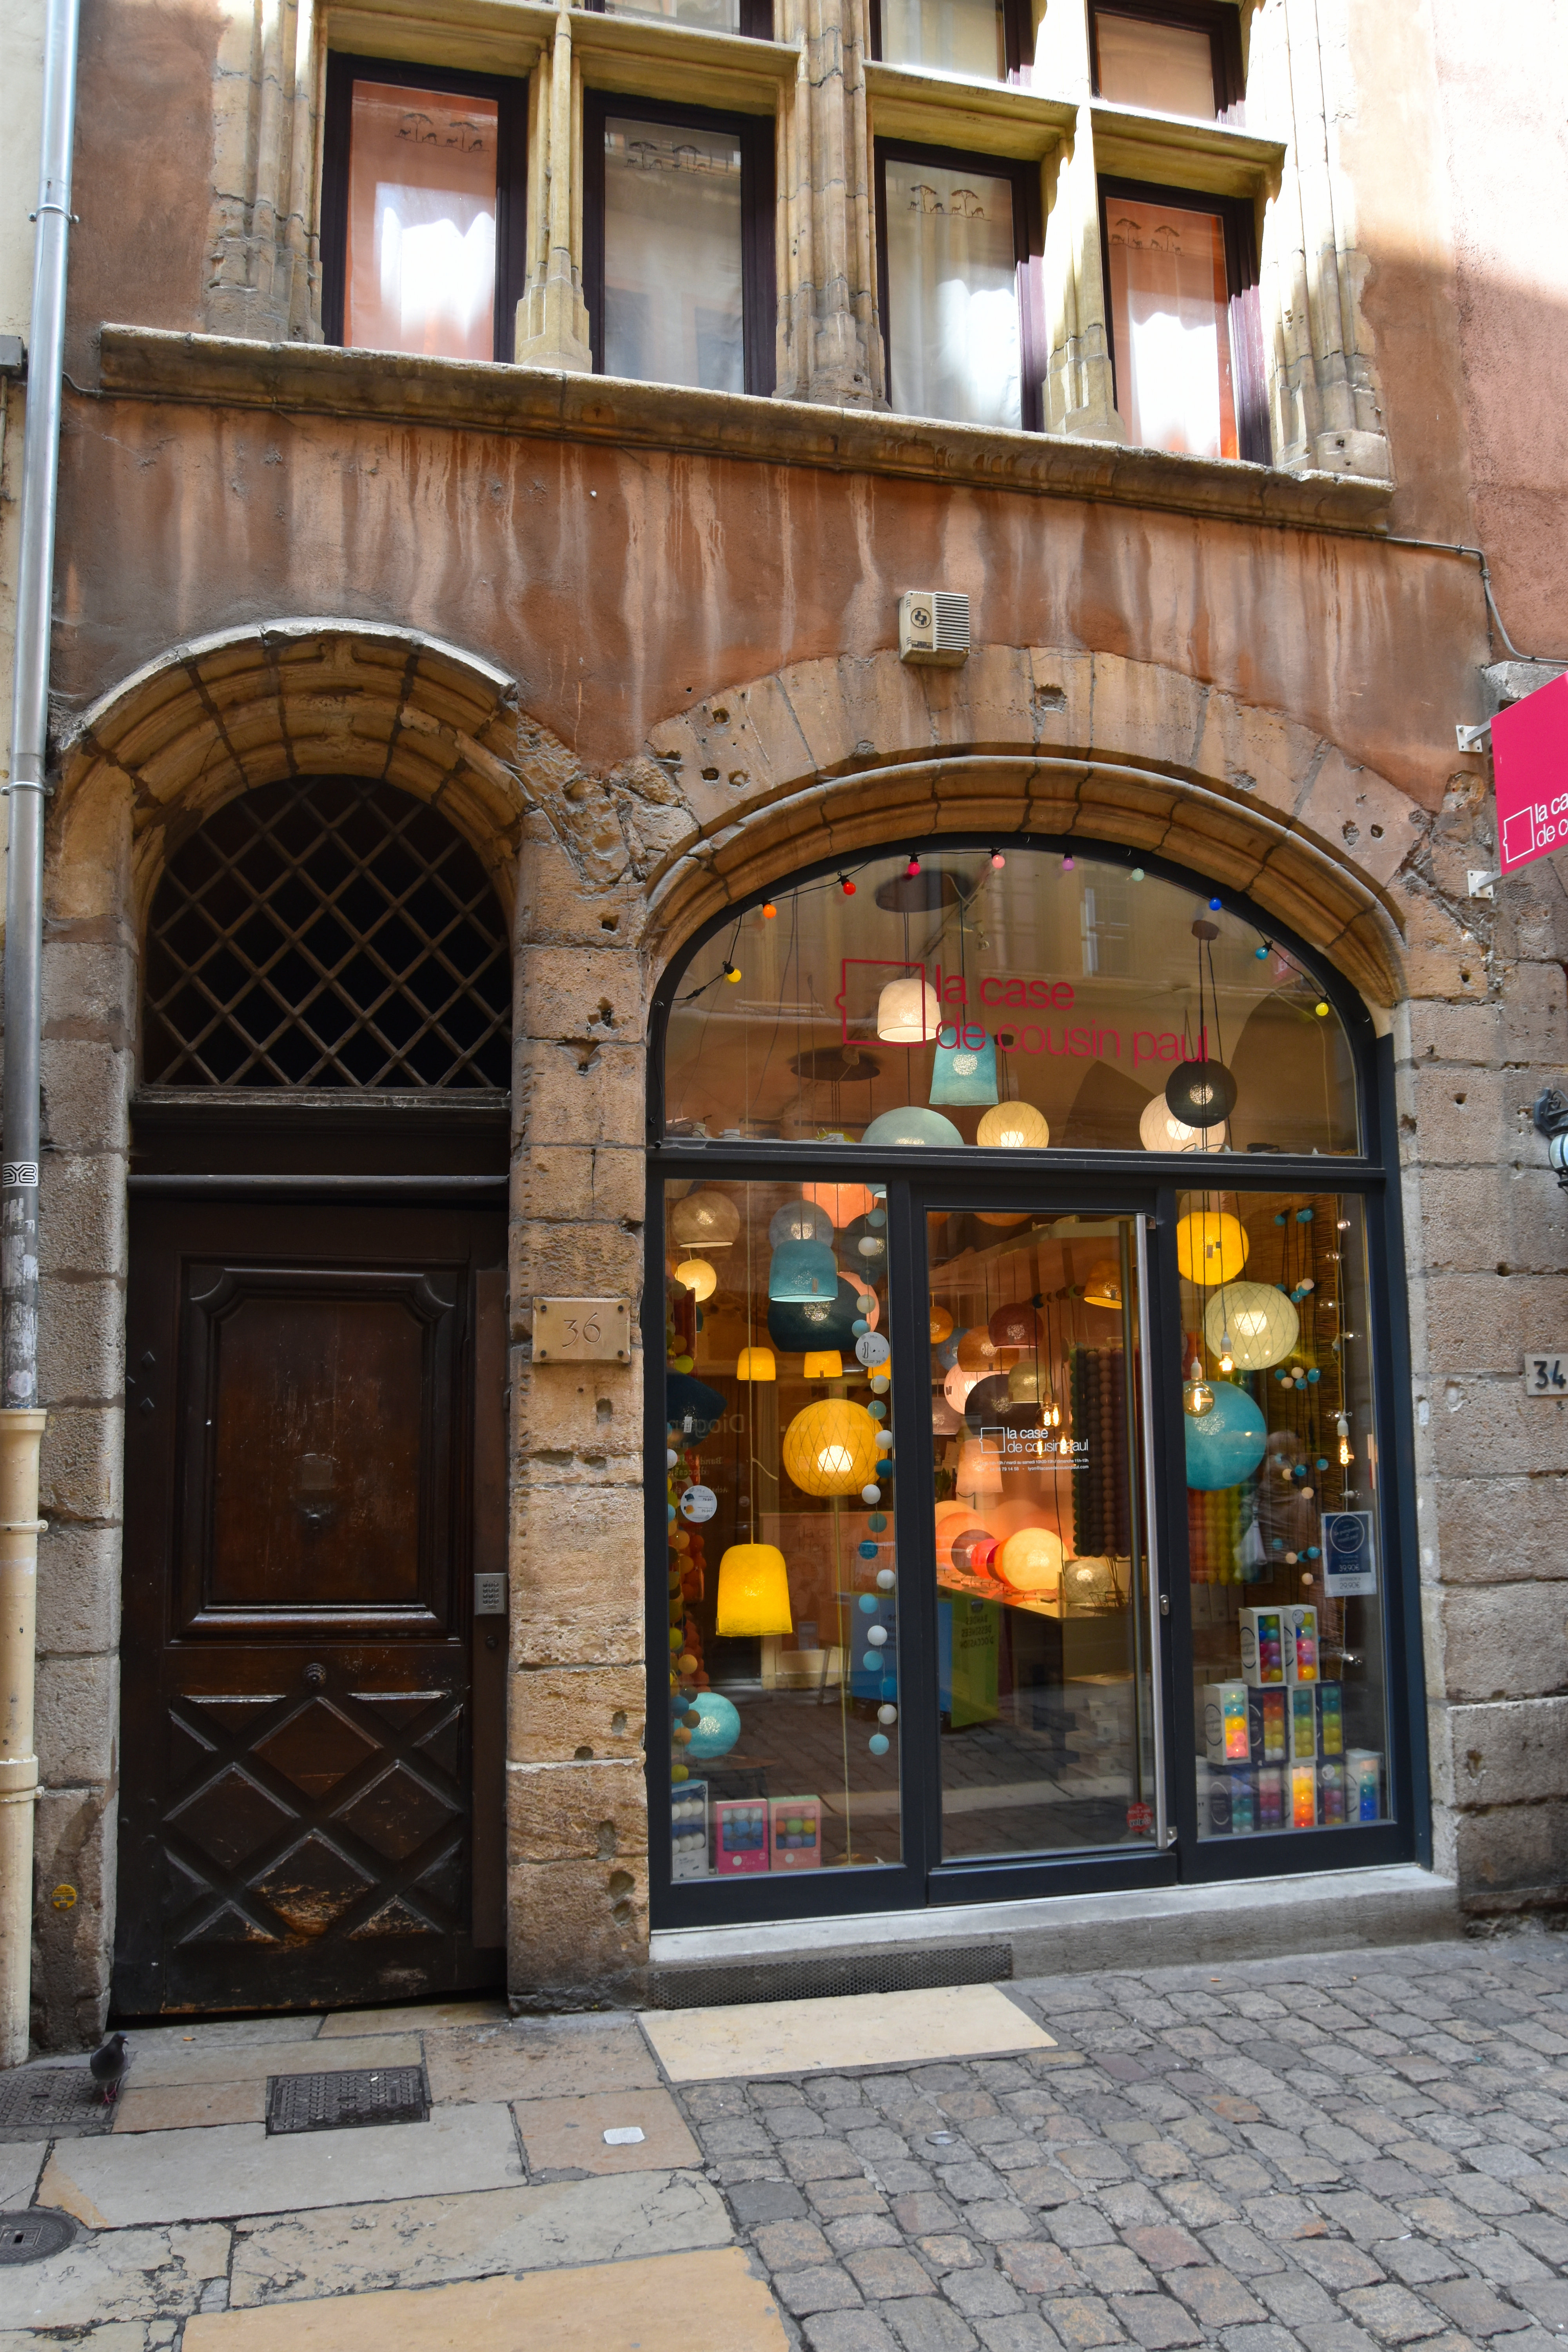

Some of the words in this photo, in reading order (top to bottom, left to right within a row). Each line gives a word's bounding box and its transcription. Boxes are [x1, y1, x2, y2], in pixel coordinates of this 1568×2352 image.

[1535, 803, 1548, 824] la
[1536, 823, 1556, 847] de
[936, 964, 968, 1005] la
[980, 975, 1075, 1011] case
[936, 1012, 986, 1051] de
[997, 1019, 1121, 1058] cousin
[1133, 1025, 1209, 1069] paul
[562, 1312, 601, 1349] 36
[1534, 1360, 1566, 1390] 34
[1007, 1427, 1017, 1439] la
[1020, 1428, 1049, 1439] case
[1007, 1441, 1022, 1453] de
[1025, 1439, 1060, 1453] cousin
[1066, 1439, 1089, 1454] paul
